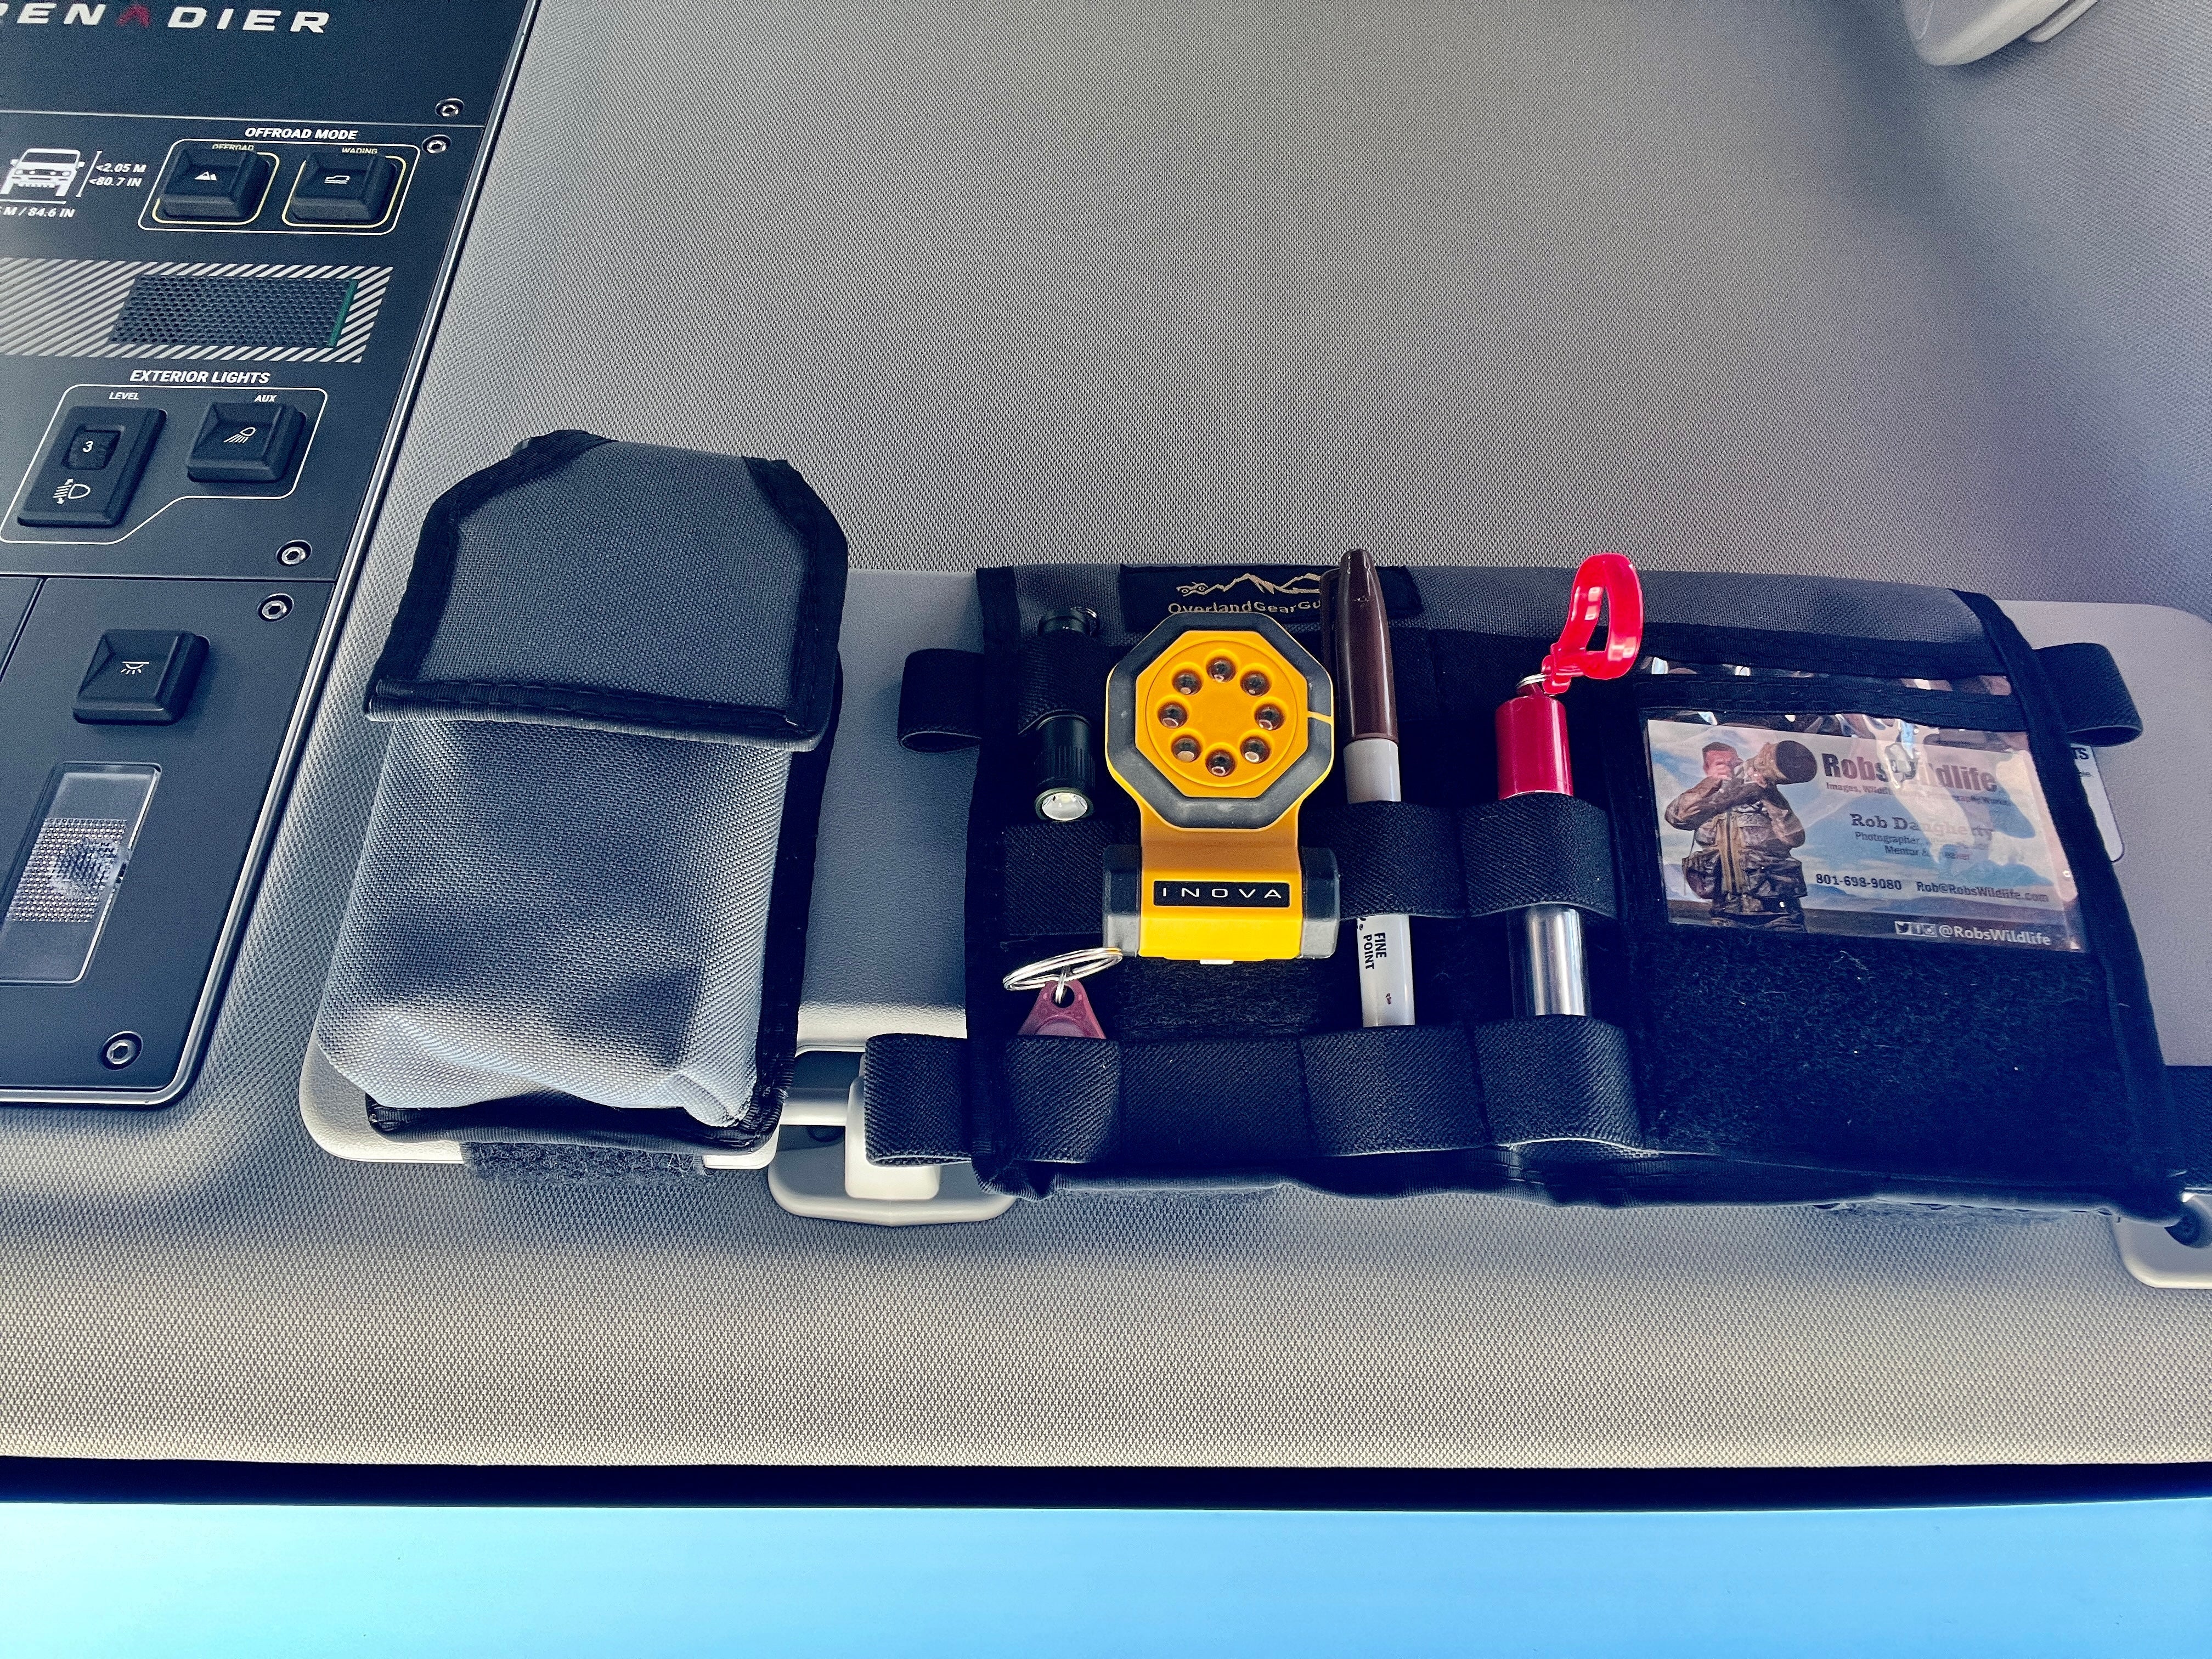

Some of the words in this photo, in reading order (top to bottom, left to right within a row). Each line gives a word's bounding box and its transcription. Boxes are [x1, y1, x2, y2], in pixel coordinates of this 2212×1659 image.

[245, 127, 312, 138] OFFROAD
[314, 129, 359, 140] MODE
[96, 163, 130, 172] <2.05
[133, 164, 147, 173] M
[89, 177, 125, 187] <80.7
[126, 178, 142, 187] IN
[3, 206, 18, 216] M
[27, 207, 57, 217] 84.6
[59, 208, 75, 218] IN
[129, 370, 209, 383] EXTERIOR
[211, 371, 270, 383] LIGHTS
[109, 392, 139, 400] LEVEL
[254, 394, 278, 403] AUX
[82, 441, 94, 453] 3
[1168, 600, 1321, 614] OverlandGearGu
[1826, 782, 1861, 794] Images,
[1849, 813, 1888, 829] Rob
[1884, 845, 1919, 856] Mentor
[1163, 888, 1282, 899] INOVA
[1816, 873, 1902, 890] 801-698-9080
[1917, 881, 2051, 902] Rob@RobsWildlife.com
[1938, 925, 2051, 945] @RobsWildlife
[1374, 932, 1387, 958] FINE
[1363, 934, 1374, 969] POINT
